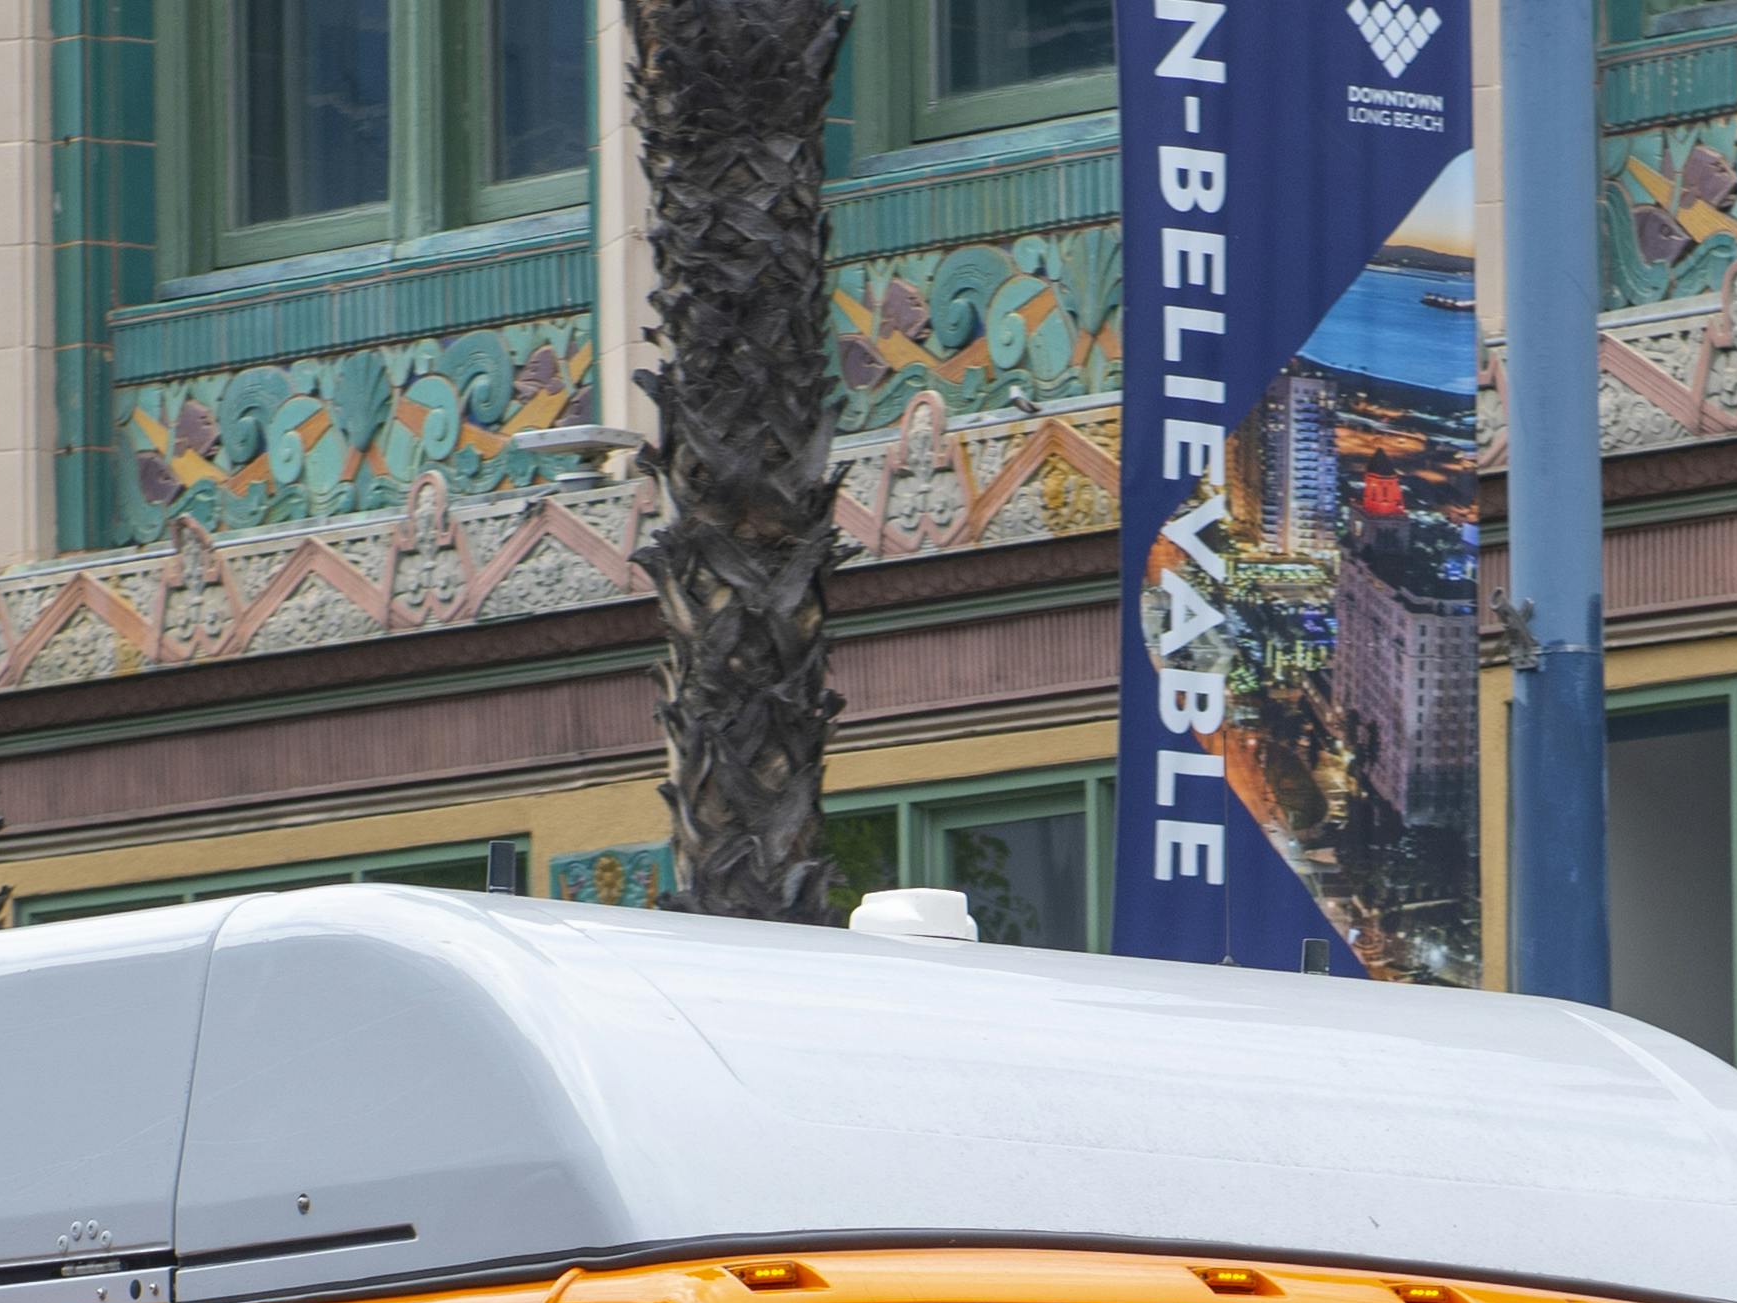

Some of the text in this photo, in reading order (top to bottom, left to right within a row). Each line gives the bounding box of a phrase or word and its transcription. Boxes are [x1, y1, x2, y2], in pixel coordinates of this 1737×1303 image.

[1347, 85, 1444, 112] DOWNTOWN
[1347, 106, 1444, 132] LONG BEACH
